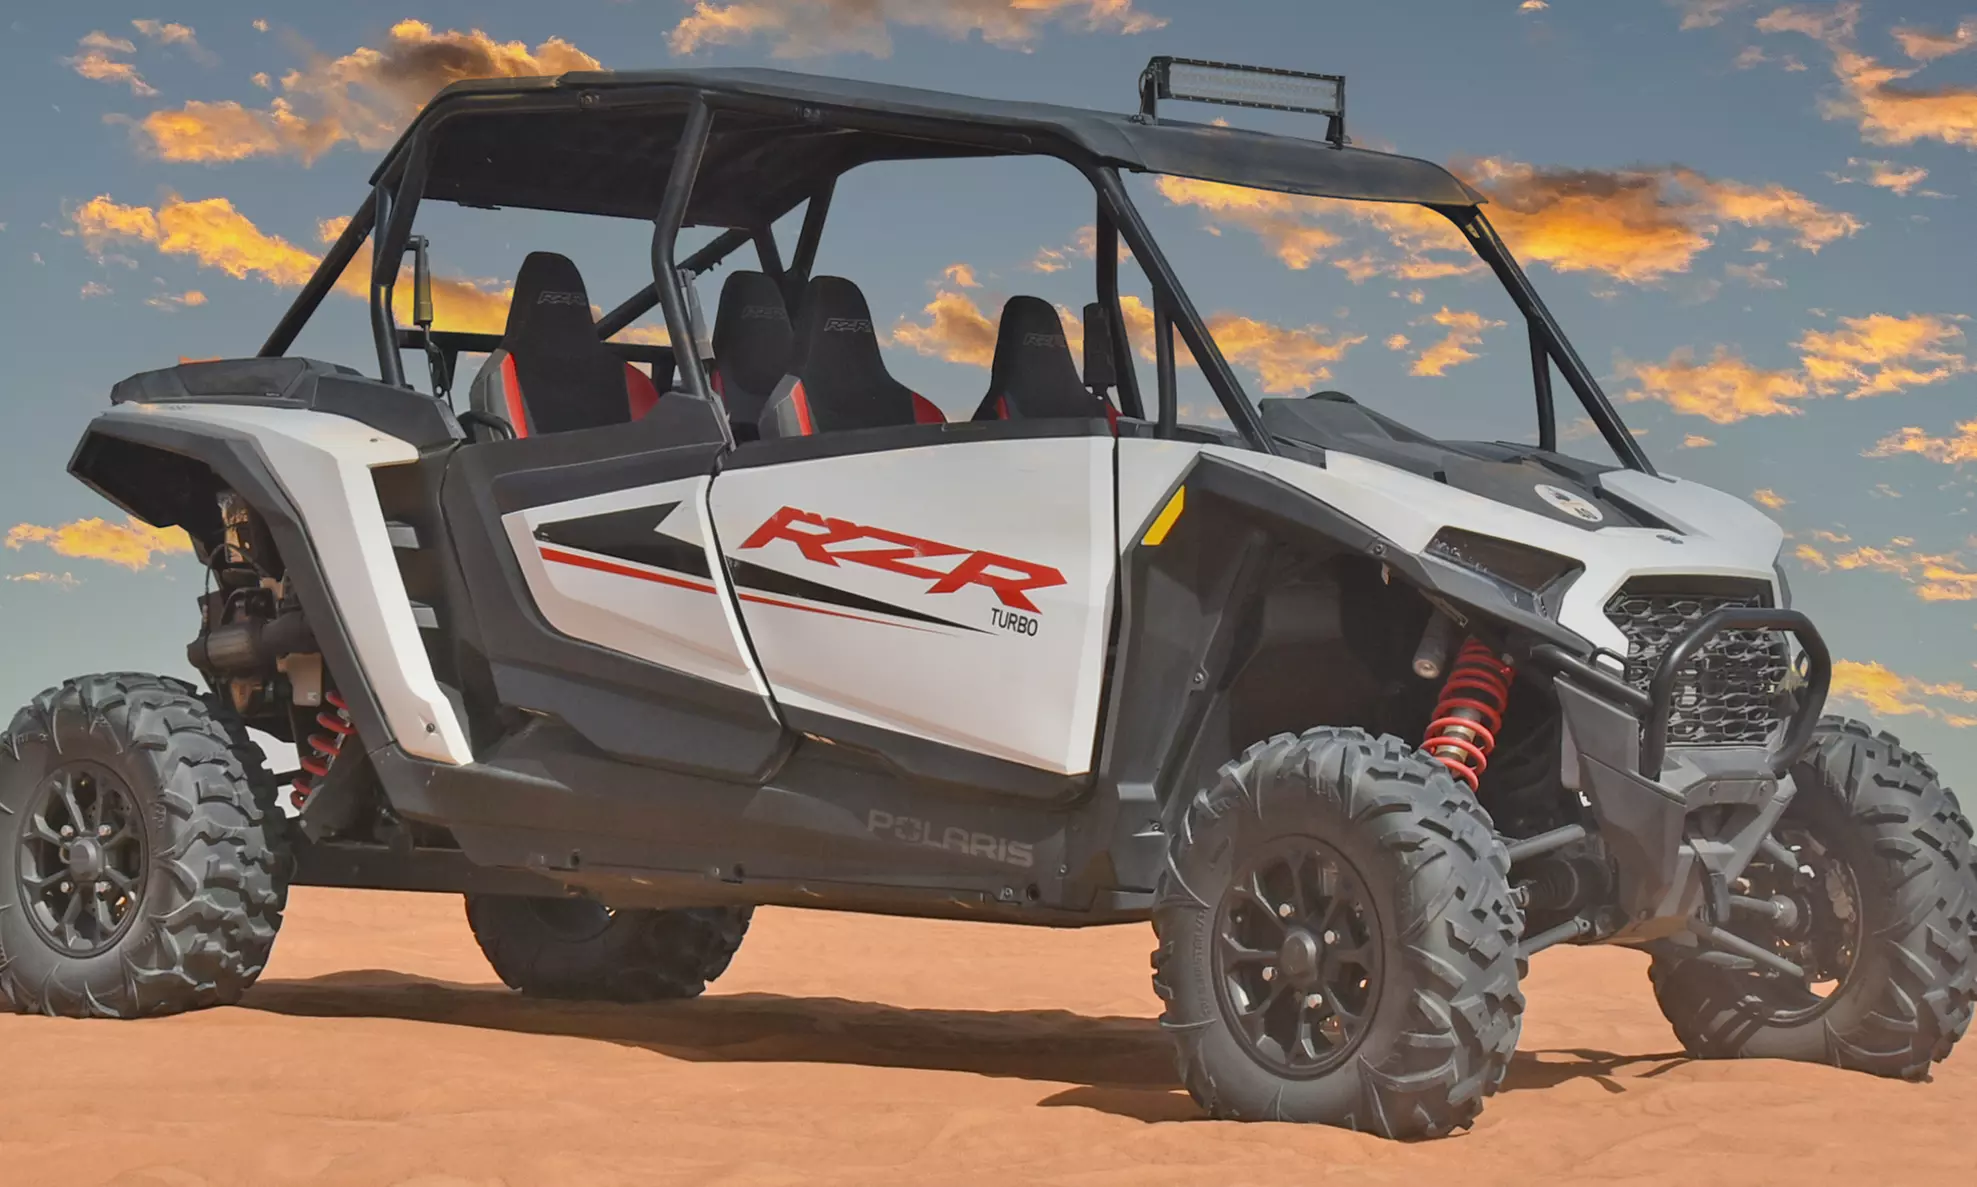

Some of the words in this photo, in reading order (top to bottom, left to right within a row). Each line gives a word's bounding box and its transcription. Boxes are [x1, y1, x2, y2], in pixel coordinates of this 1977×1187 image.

[737, 505, 1068, 615] RZR
[991, 607, 1039, 637] TURBO
[867, 809, 1034, 868] POLARIS
